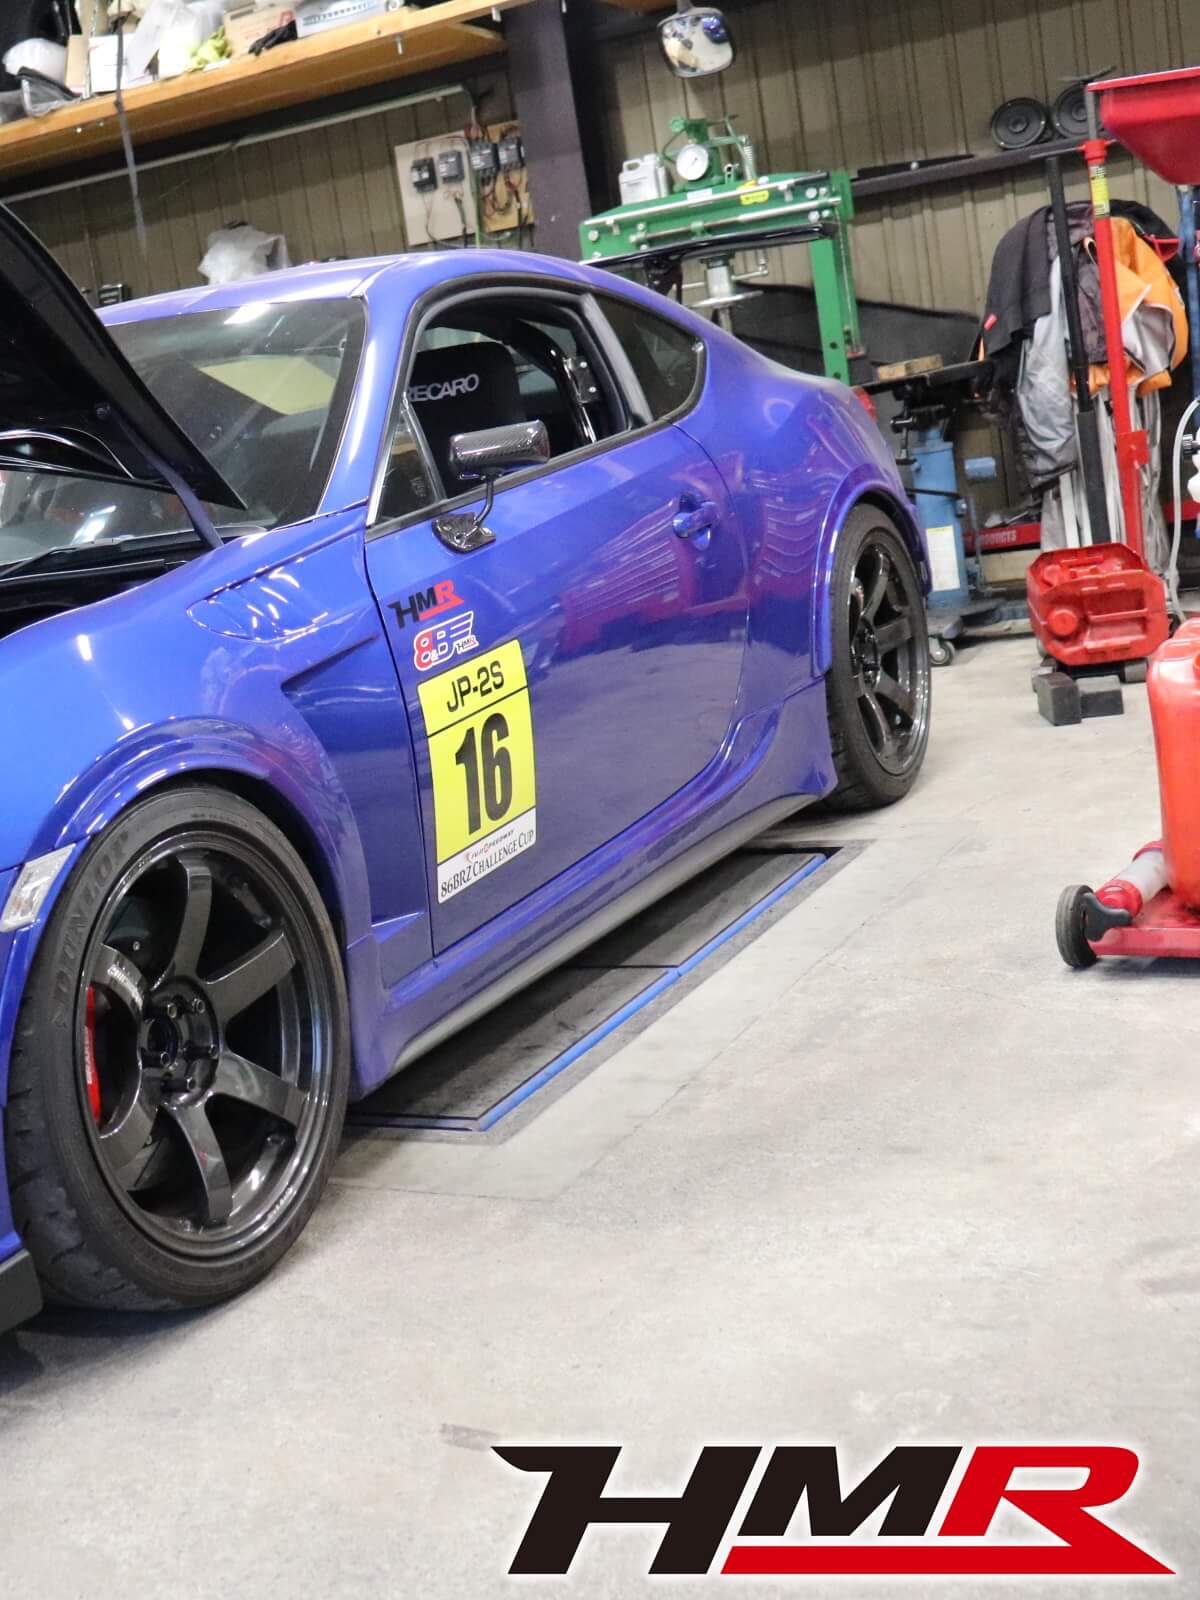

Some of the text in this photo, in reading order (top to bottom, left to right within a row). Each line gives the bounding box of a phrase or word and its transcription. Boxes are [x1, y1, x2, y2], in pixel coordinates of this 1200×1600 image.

[387, 579, 465, 629] HMR
[446, 660, 505, 713] JP-2S
[455, 712, 513, 836] 16
[440, 865, 473, 898] 86BRZ
[472, 839, 518, 877] CHALLENGE
